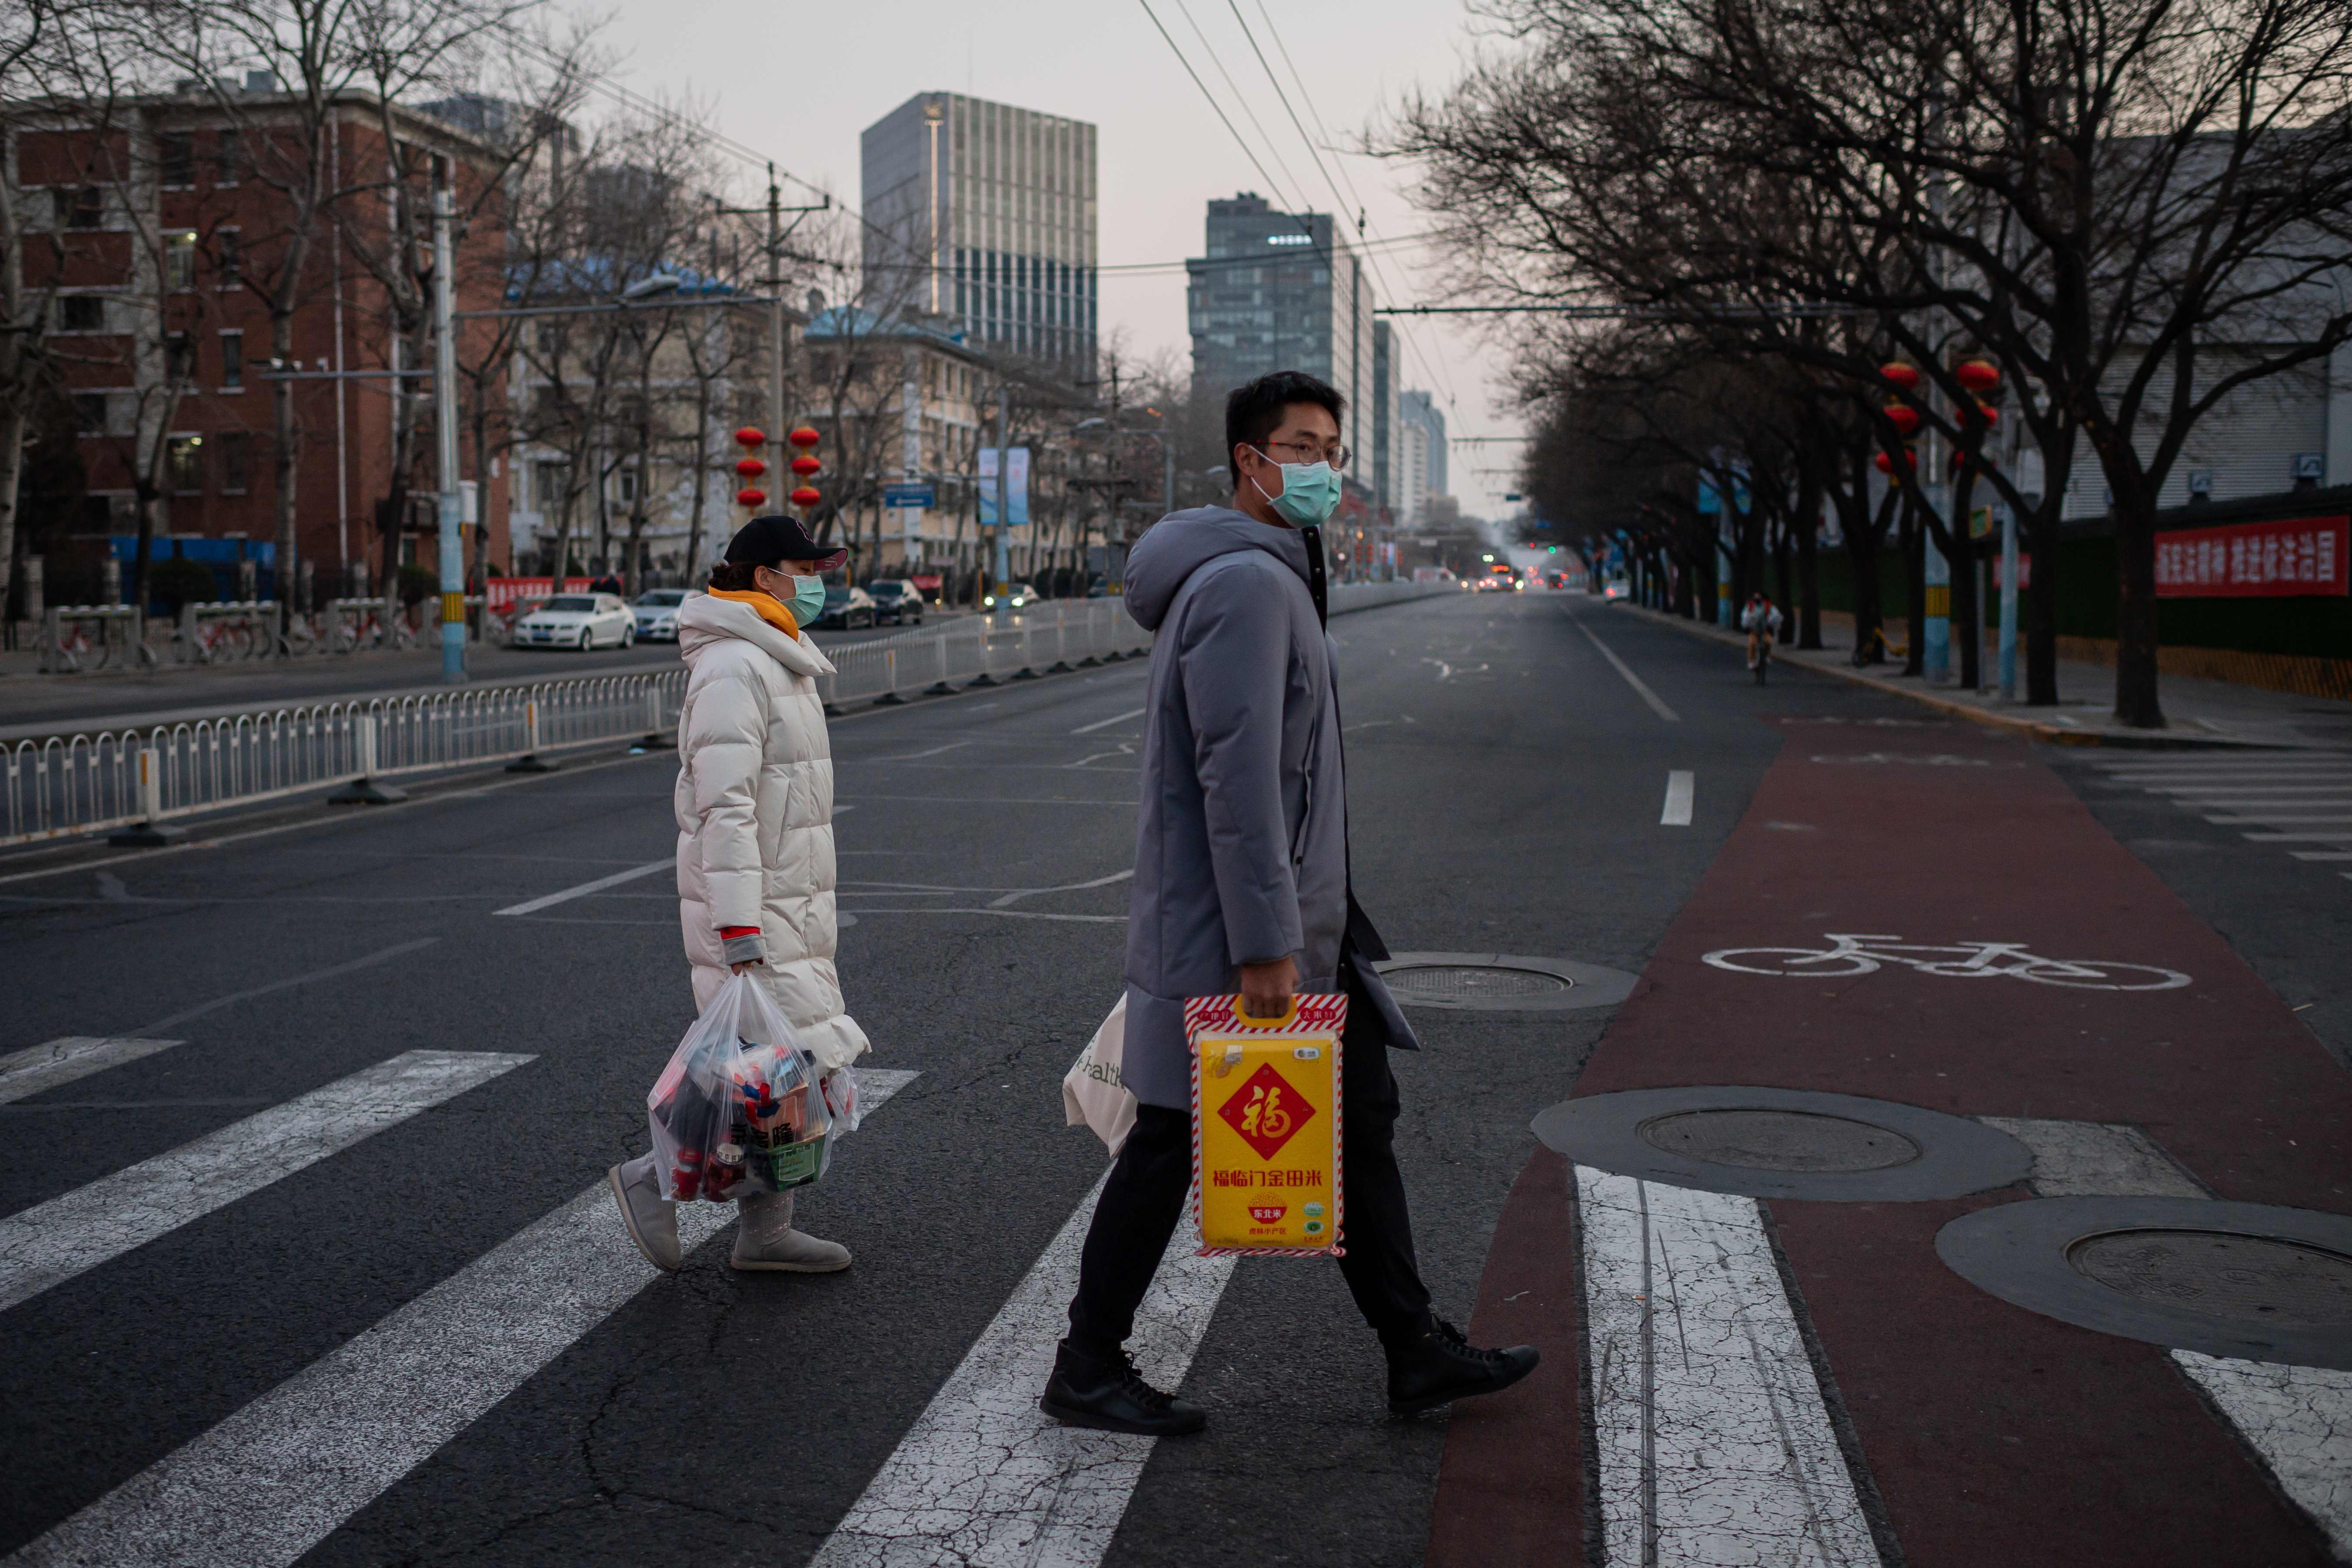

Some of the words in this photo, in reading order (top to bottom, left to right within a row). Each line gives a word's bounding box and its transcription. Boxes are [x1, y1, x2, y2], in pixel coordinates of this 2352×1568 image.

[1083, 1055, 1124, 1089] halth
[1240, 1085, 1291, 1138] 福
[1213, 1169, 1322, 1187] 福临门金田米
[1253, 1209, 1281, 1219] 东北米
